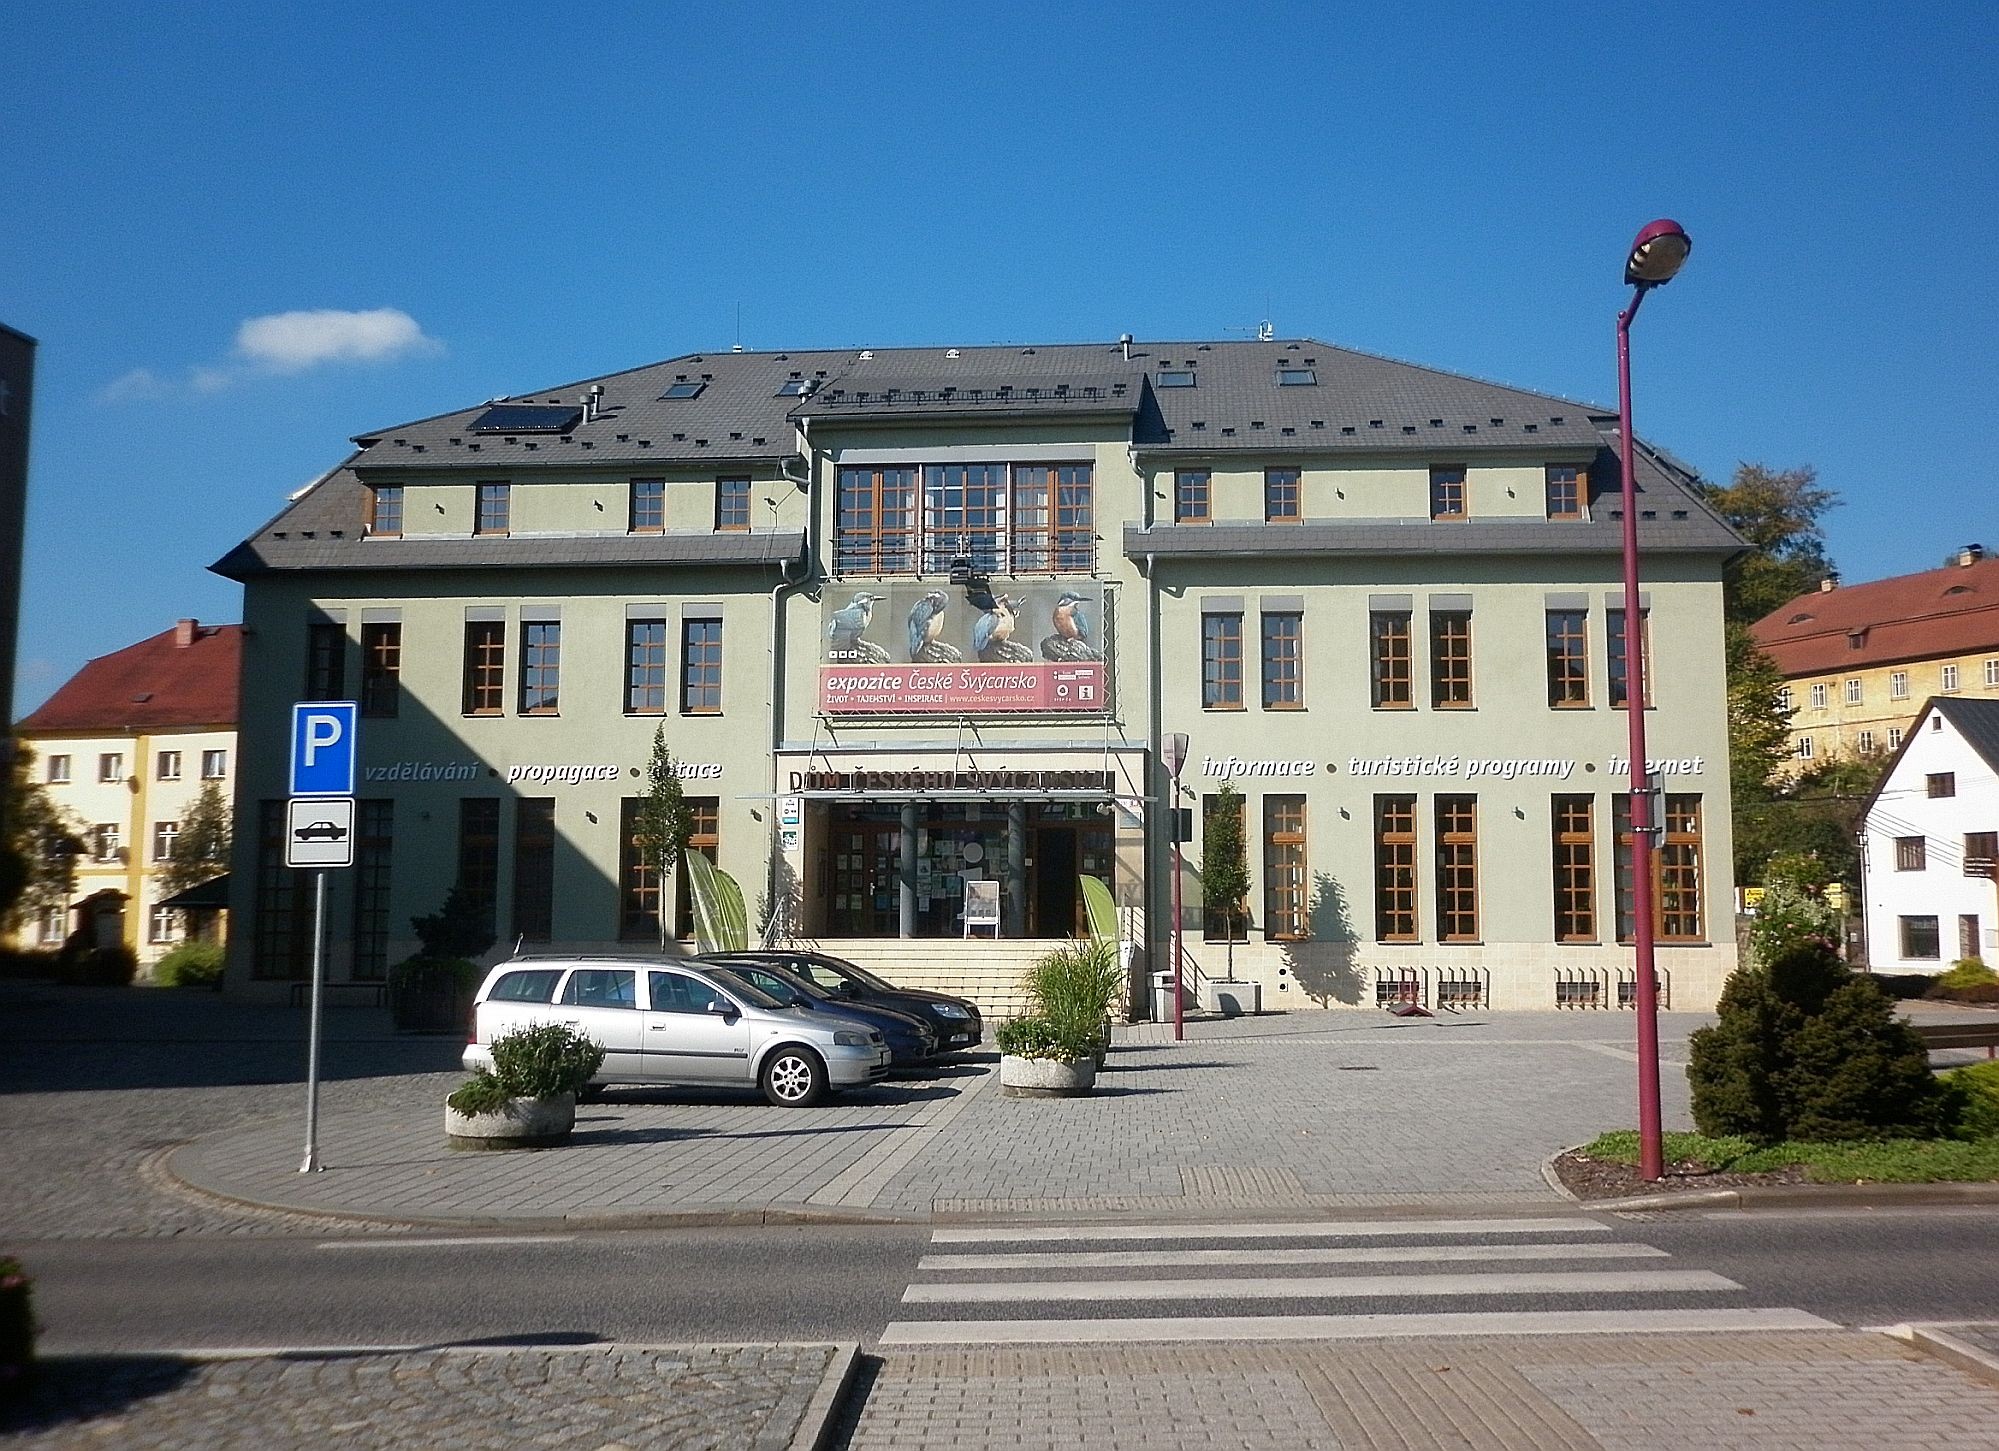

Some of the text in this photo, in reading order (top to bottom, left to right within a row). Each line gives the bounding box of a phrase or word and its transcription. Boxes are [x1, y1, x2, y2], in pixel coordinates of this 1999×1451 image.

[827, 672, 903, 694] expozice
[909, 669, 953, 690] České
[959, 669, 1037, 694] Švýcarsko
[827, 694, 848, 703] ŽIVOT
[904, 694, 943, 703] INSPIRACE
[950, 694, 1035, 704] www.ceskesvycarsko.cz
[305, 715, 342, 766] P
[365, 761, 480, 781] vzdělávání
[507, 762, 619, 785] propagace
[790, 765, 841, 790] DŮM
[853, 765, 955, 790] ČESKÉHO
[1201, 754, 1704, 780] informace turistické programy inernet
